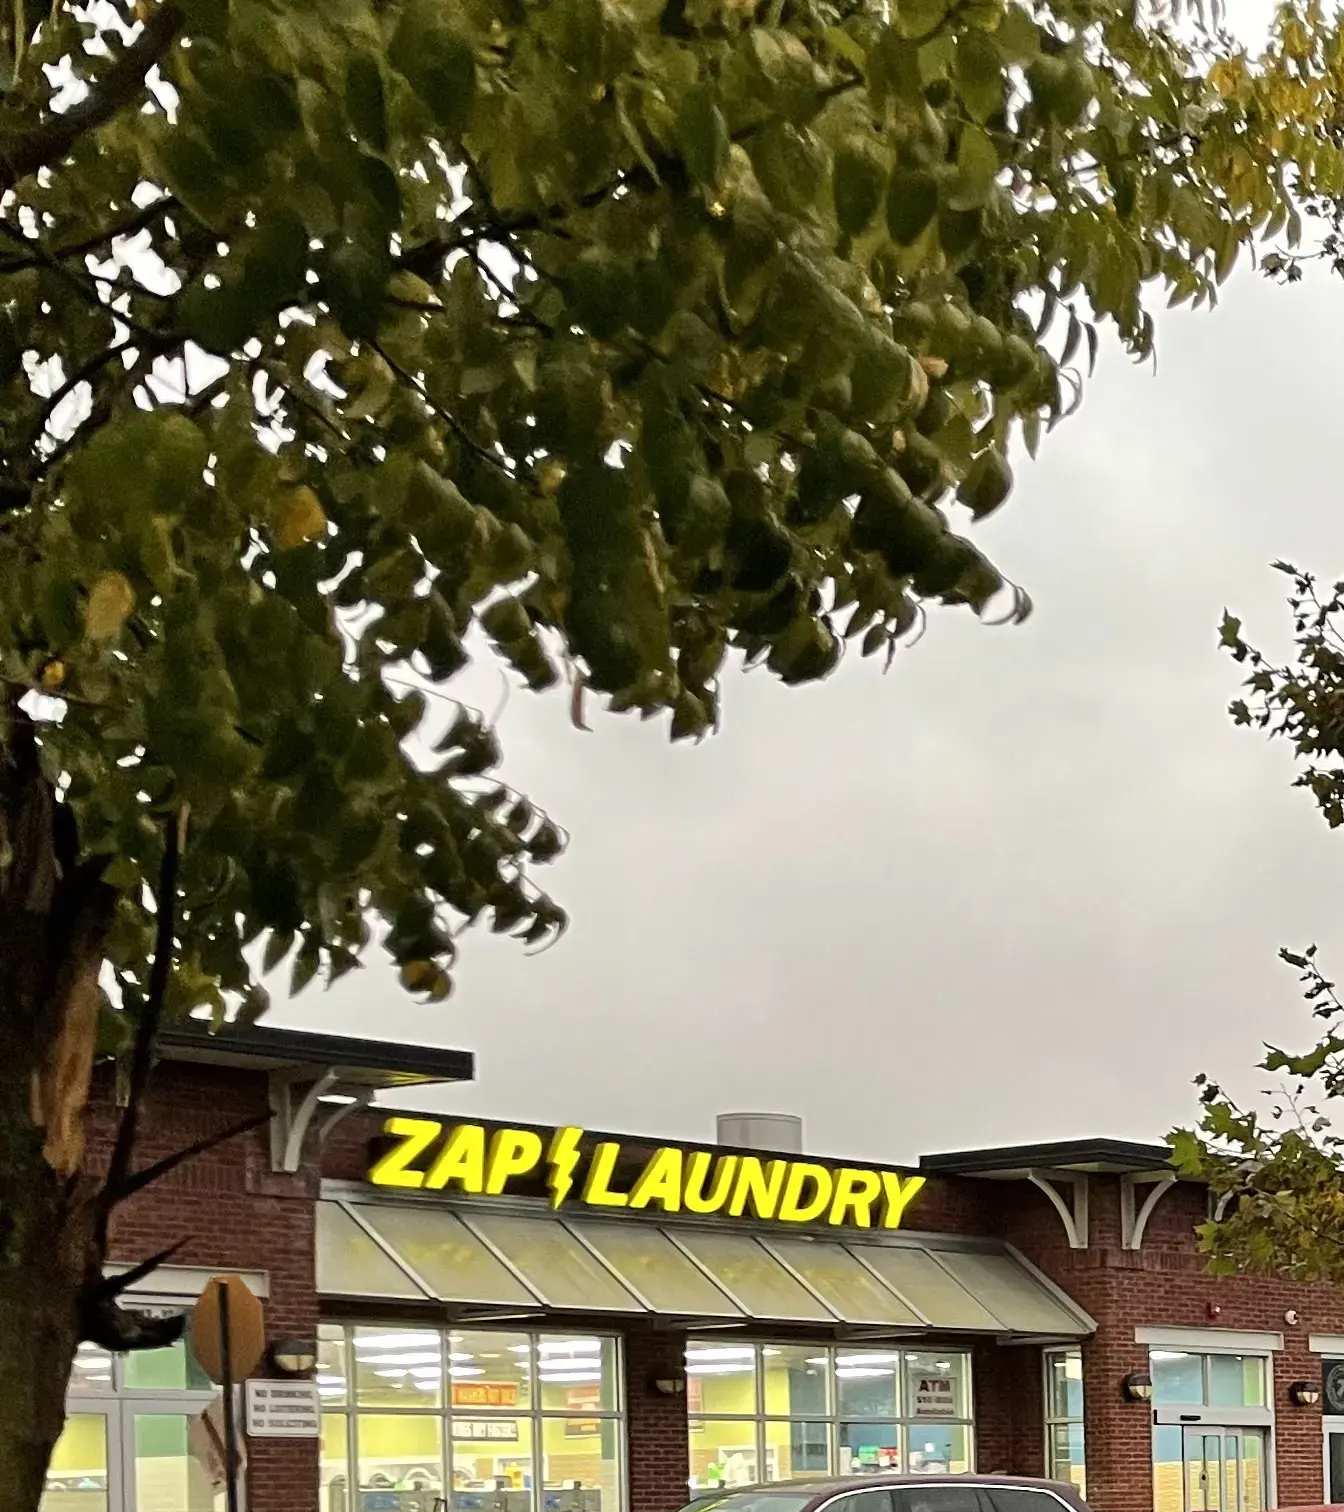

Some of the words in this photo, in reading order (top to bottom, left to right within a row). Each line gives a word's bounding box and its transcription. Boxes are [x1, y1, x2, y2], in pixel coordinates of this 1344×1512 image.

[370, 1117, 541, 1195] ZAP
[582, 1141, 926, 1229] LAUNDRY
[919, 1380, 950, 1392] ATM
